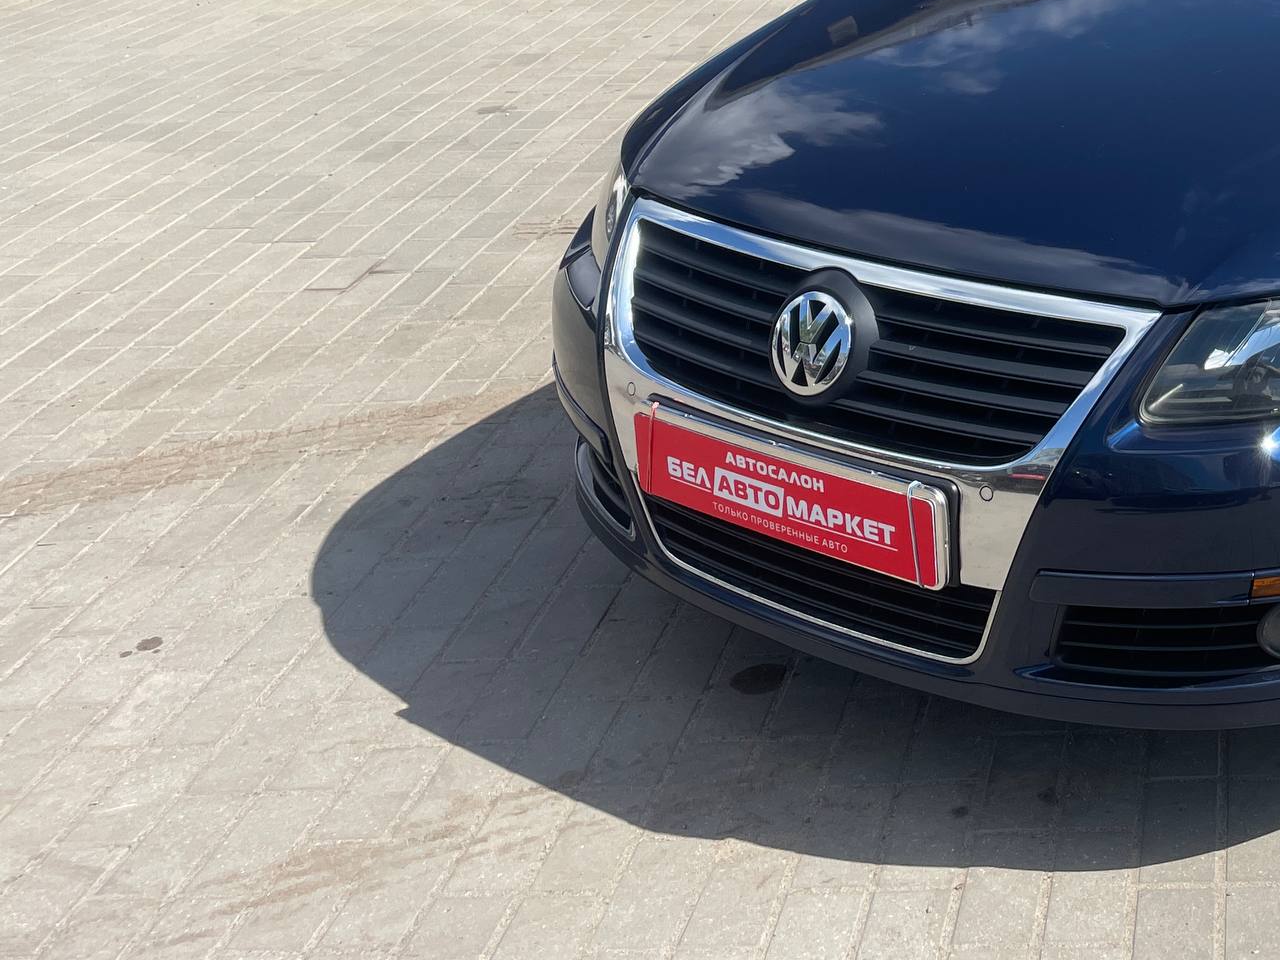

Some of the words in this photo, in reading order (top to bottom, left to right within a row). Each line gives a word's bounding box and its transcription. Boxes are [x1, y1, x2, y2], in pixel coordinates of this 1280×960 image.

[725, 451, 825, 493] АВТОСАЛОН
[667, 456, 711, 488] БЕЛ
[718, 475, 780, 510] АВТО
[786, 495, 896, 545] МАРКЕТ
[712, 501, 749, 521] ТОЛЬКО
[750, 514, 820, 544] ПРОВЕРЕННЫЕ
[821, 538, 848, 553] АВТО
